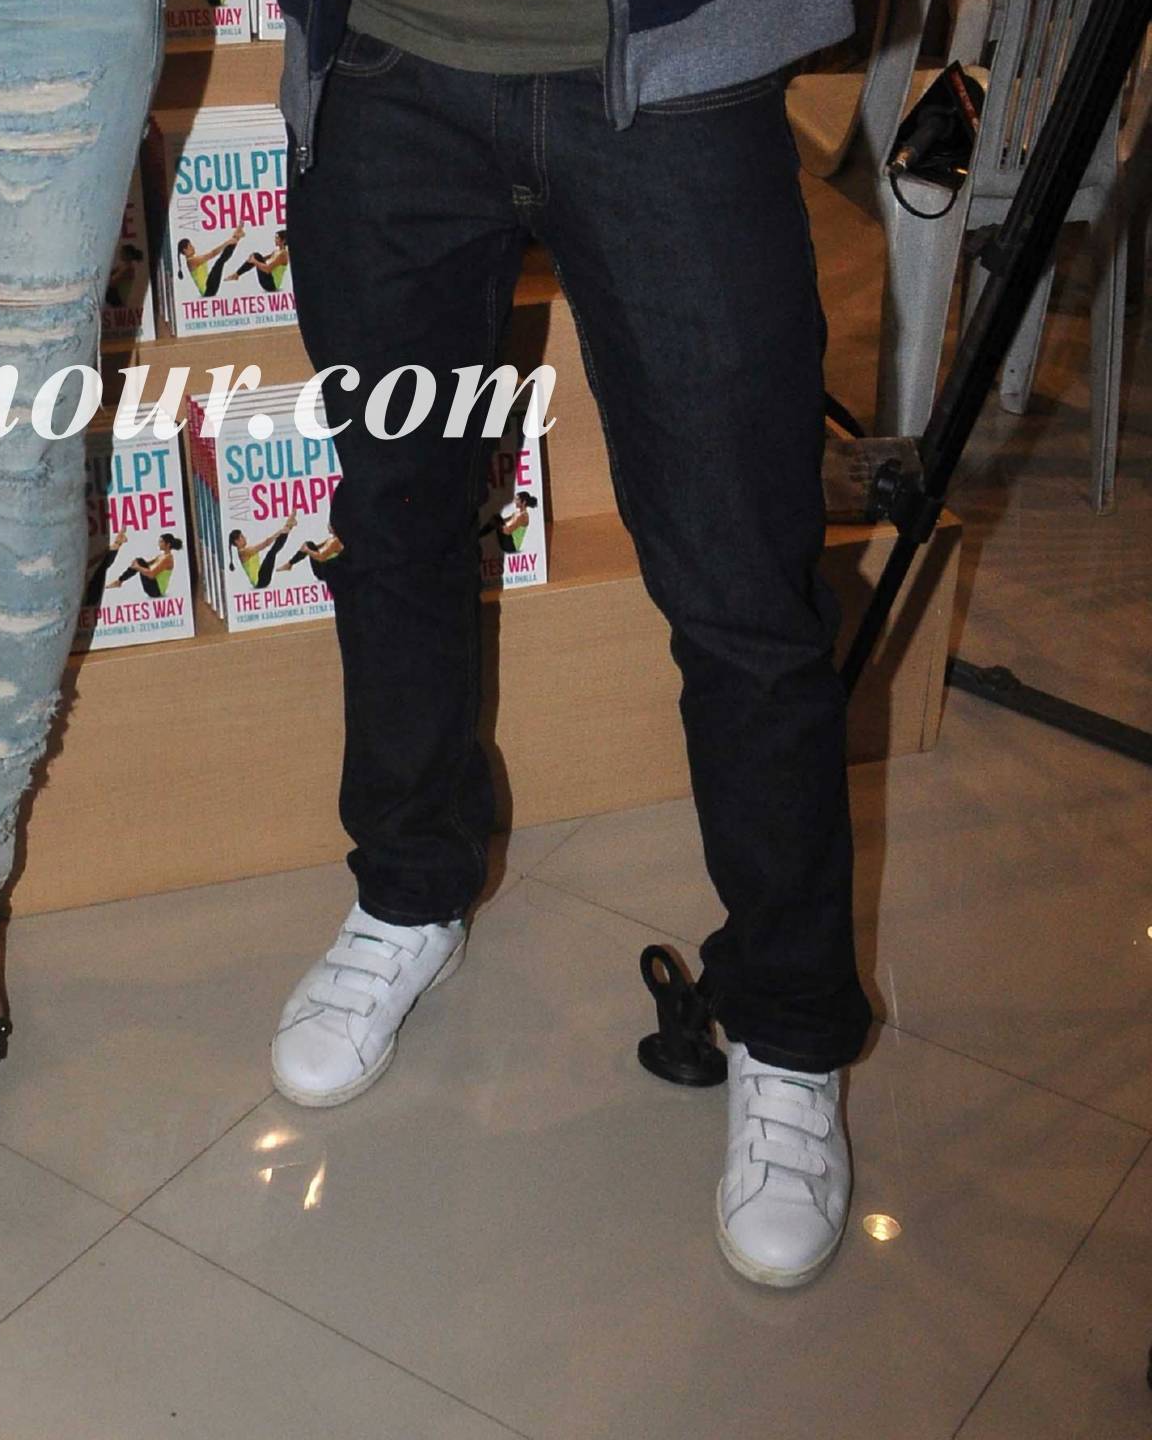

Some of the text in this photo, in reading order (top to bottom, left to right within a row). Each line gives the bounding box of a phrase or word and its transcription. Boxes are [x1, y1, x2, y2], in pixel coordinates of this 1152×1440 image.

[213, 7, 242, 27] WAY
[175, 148, 288, 196] SCULPT
[200, 189, 288, 231] SHAPE
[182, 292, 297, 320] THE PILATES WAY
[508, 553, 538, 573] WAY
[94, 600, 150, 626] PILATES
[153, 597, 185, 620] WAY
[233, 593, 261, 613] THE
[264, 584, 319, 610] PILATES
